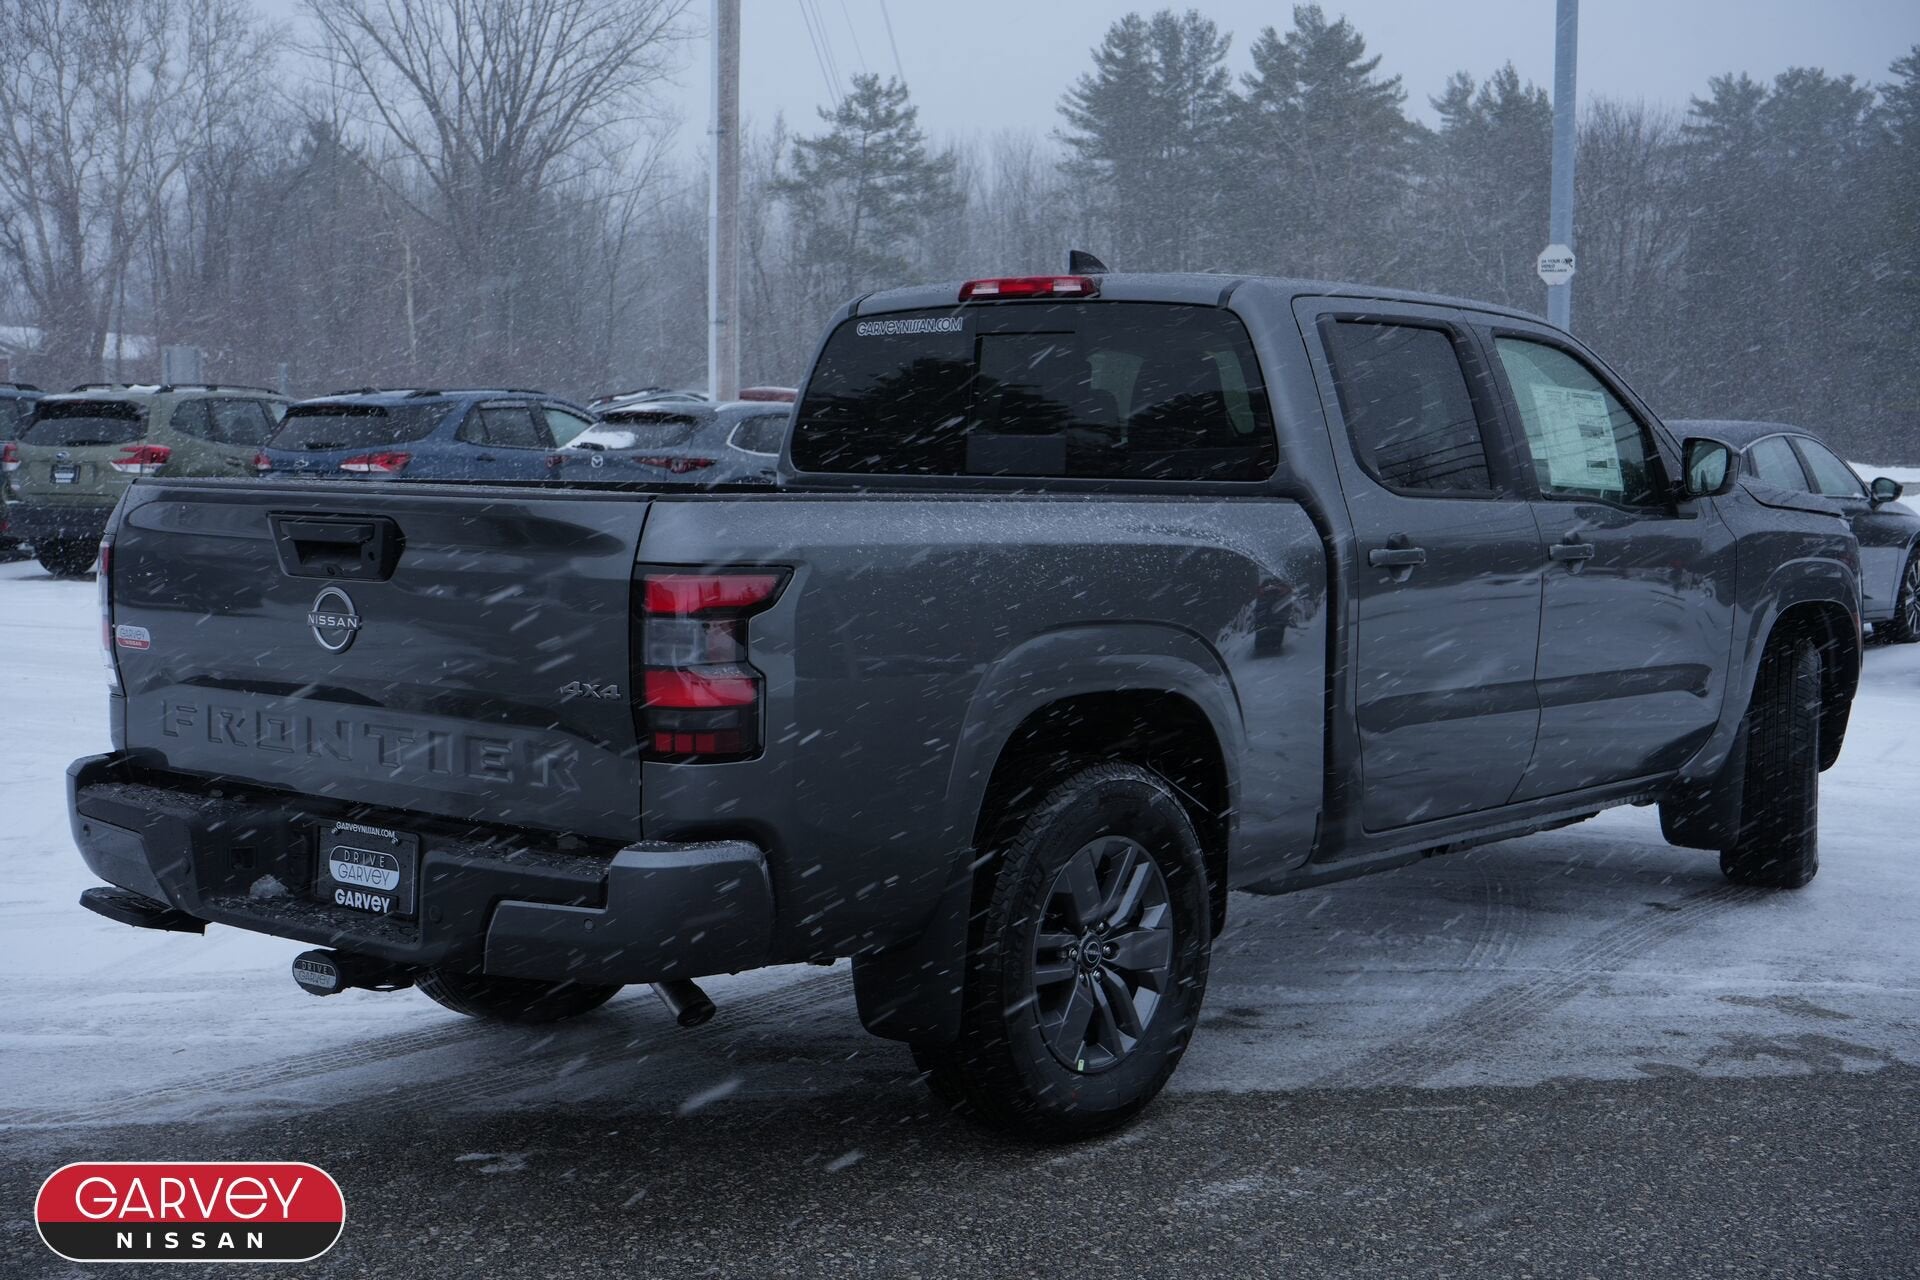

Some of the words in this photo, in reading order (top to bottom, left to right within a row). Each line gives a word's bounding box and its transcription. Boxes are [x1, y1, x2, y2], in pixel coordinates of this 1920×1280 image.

[308, 613, 358, 628] NISSAN
[162, 700, 581, 792] FRONTIER
[344, 850, 385, 868] DRIVE
[302, 961, 329, 975] DRIVE
